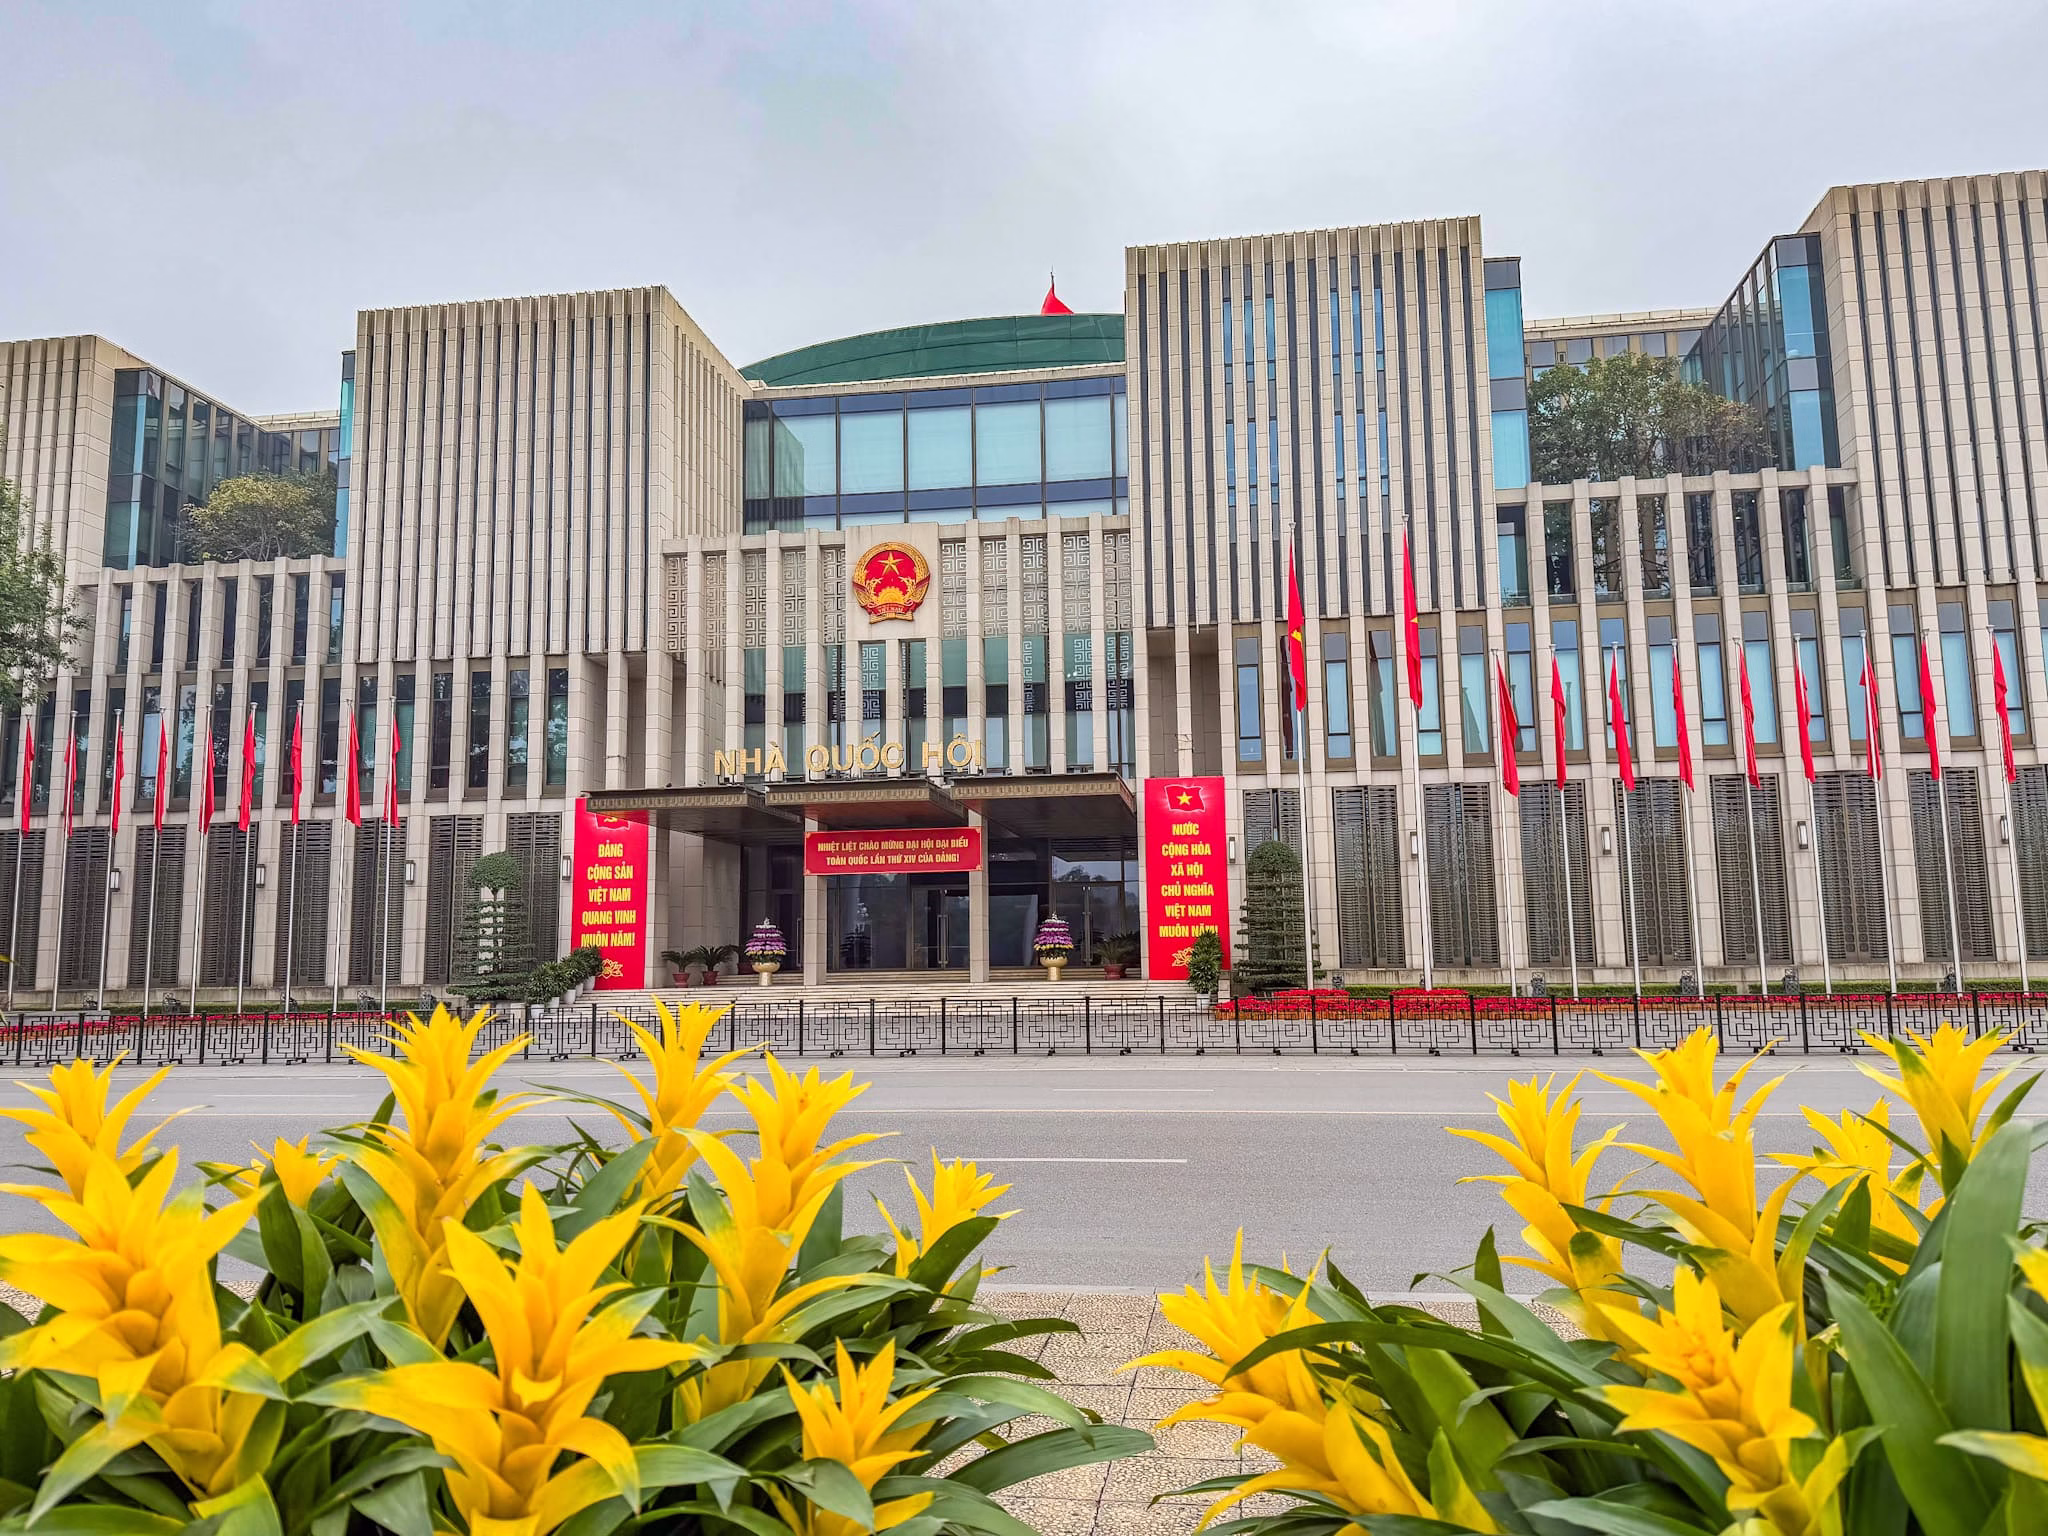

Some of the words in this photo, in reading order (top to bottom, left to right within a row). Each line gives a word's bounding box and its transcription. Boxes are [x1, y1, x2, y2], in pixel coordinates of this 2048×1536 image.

[714, 742, 788, 776] NHÀ
[805, 731, 904, 773] QUỐC
[921, 732, 982, 773] HỘI
[1172, 821, 1200, 836] NƯỚC
[598, 840, 624, 858] ĐẢNG
[817, 841, 840, 853] NHIỆT
[841, 841, 857, 852] LIỆT
[858, 840, 879, 850] CHÀO
[881, 839, 904, 850] MỪNG
[921, 838, 934, 850] HỘI
[1161, 842, 1188, 858] CỘNG
[1191, 841, 1212, 856] HÒA
[826, 855, 846, 866] TOÀN
[848, 853, 869, 866] QUỐC
[887, 853, 902, 864] THỨ
[903, 854, 917, 864] XIV
[918, 851, 933, 863] CỦA
[587, 863, 612, 884] CỘNG
[614, 861, 634, 880] SẢN
[1171, 862, 1184, 877] XÃ
[1187, 862, 1204, 879] HỘI
[588, 886, 608, 905] VIỆT
[609, 888, 632, 902] NAM
[1161, 881, 1181, 897] CHỦ
[1183, 882, 1215, 897] NGHĨA
[582, 910, 612, 927] QUANG
[615, 910, 637, 924] VINH
[1165, 903, 1186, 920] VIỆT
[1188, 905, 1212, 917] NAM
[581, 931, 609, 948] MUÔN
[610, 930, 636, 947] NĂM!
[1159, 923, 1189, 938] MUÔN
